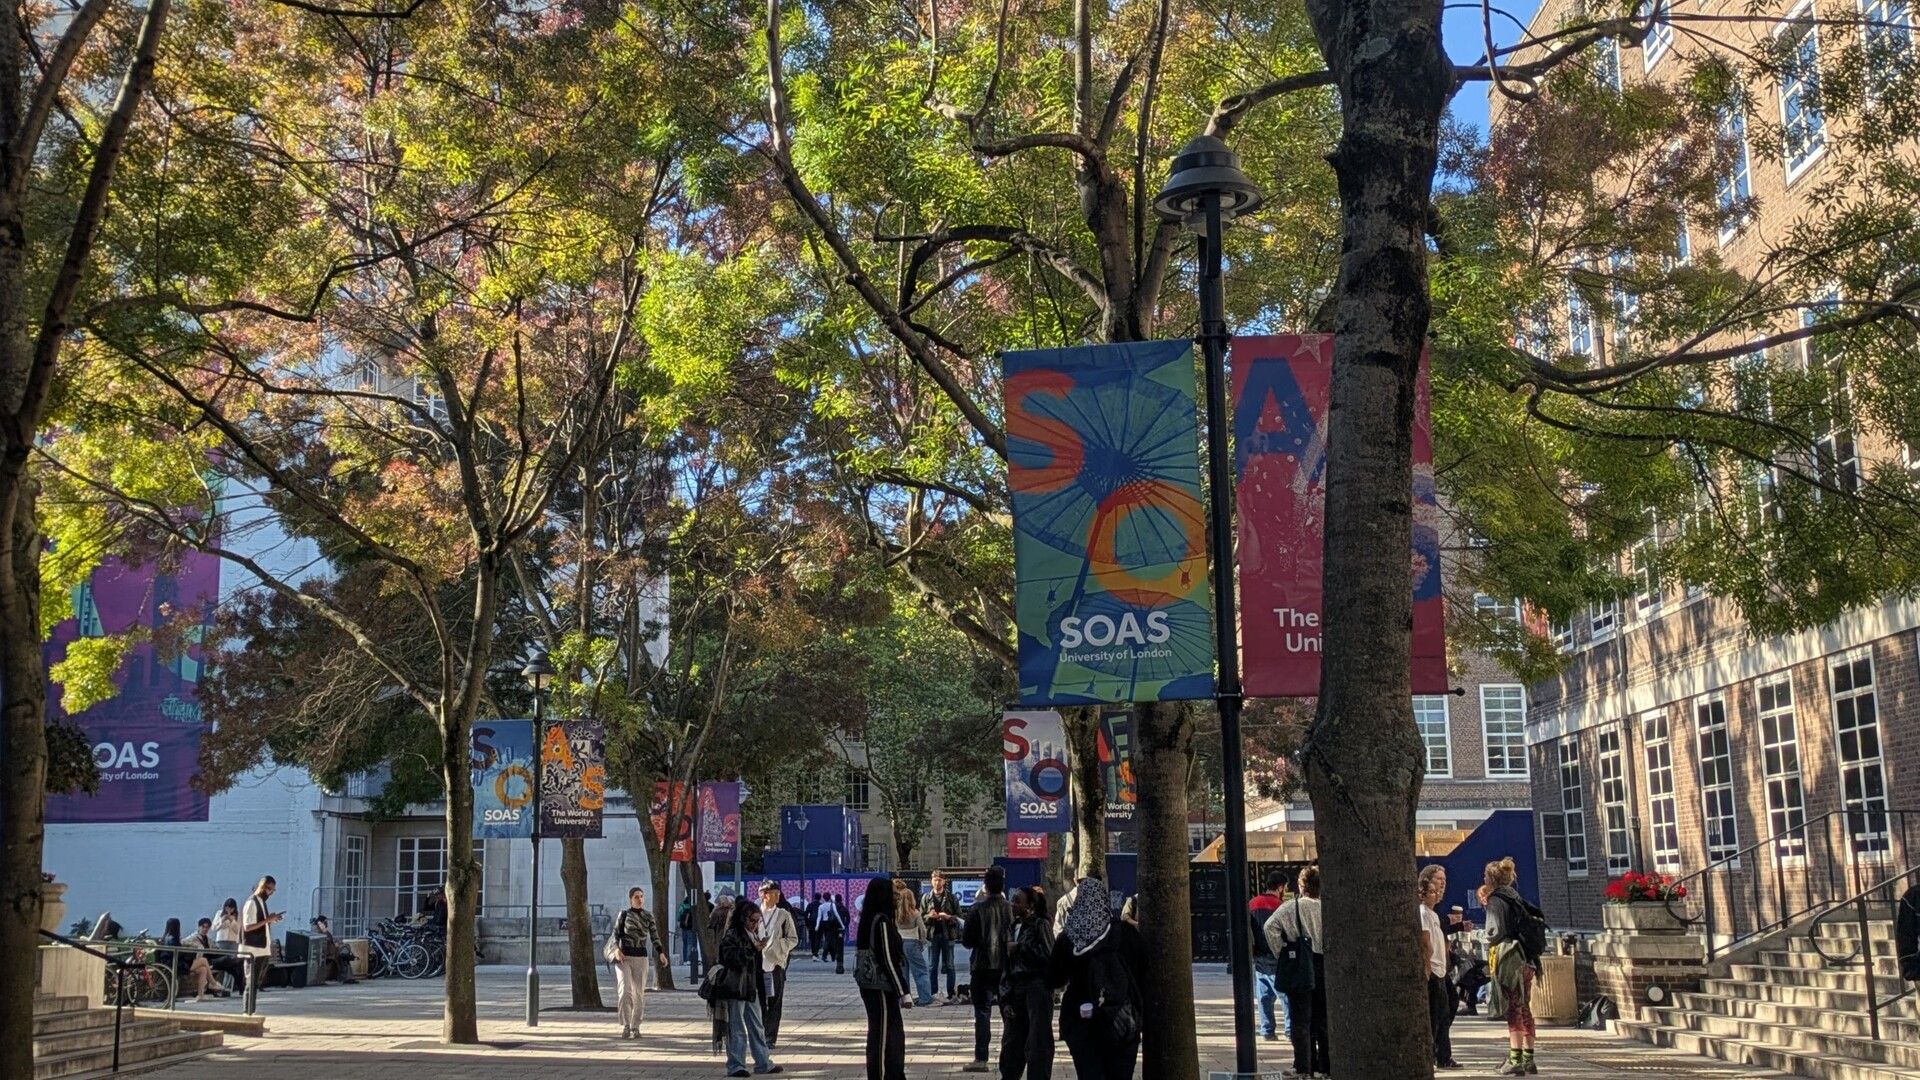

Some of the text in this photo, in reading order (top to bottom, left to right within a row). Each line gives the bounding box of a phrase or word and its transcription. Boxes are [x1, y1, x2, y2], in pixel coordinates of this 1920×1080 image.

[1273, 608, 1319, 627] The
[1059, 610, 1171, 648] SOAS
[1286, 632, 1323, 652] Uni
[1059, 648, 1172, 663] University of London
[1003, 718, 1030, 761] S
[86, 741, 160, 769] OAS
[114, 771, 125, 780] of
[125, 771, 159, 780] London
[551, 808, 594, 817] The World's
[1020, 802, 1057, 814] SOAS
[1107, 802, 1135, 811] World's
[484, 809, 520, 821] SOAS
[1105, 811, 1133, 820] iversity
[554, 817, 591, 827] University
[659, 840, 684, 851] SAS
[1017, 838, 1042, 846] SOAS
